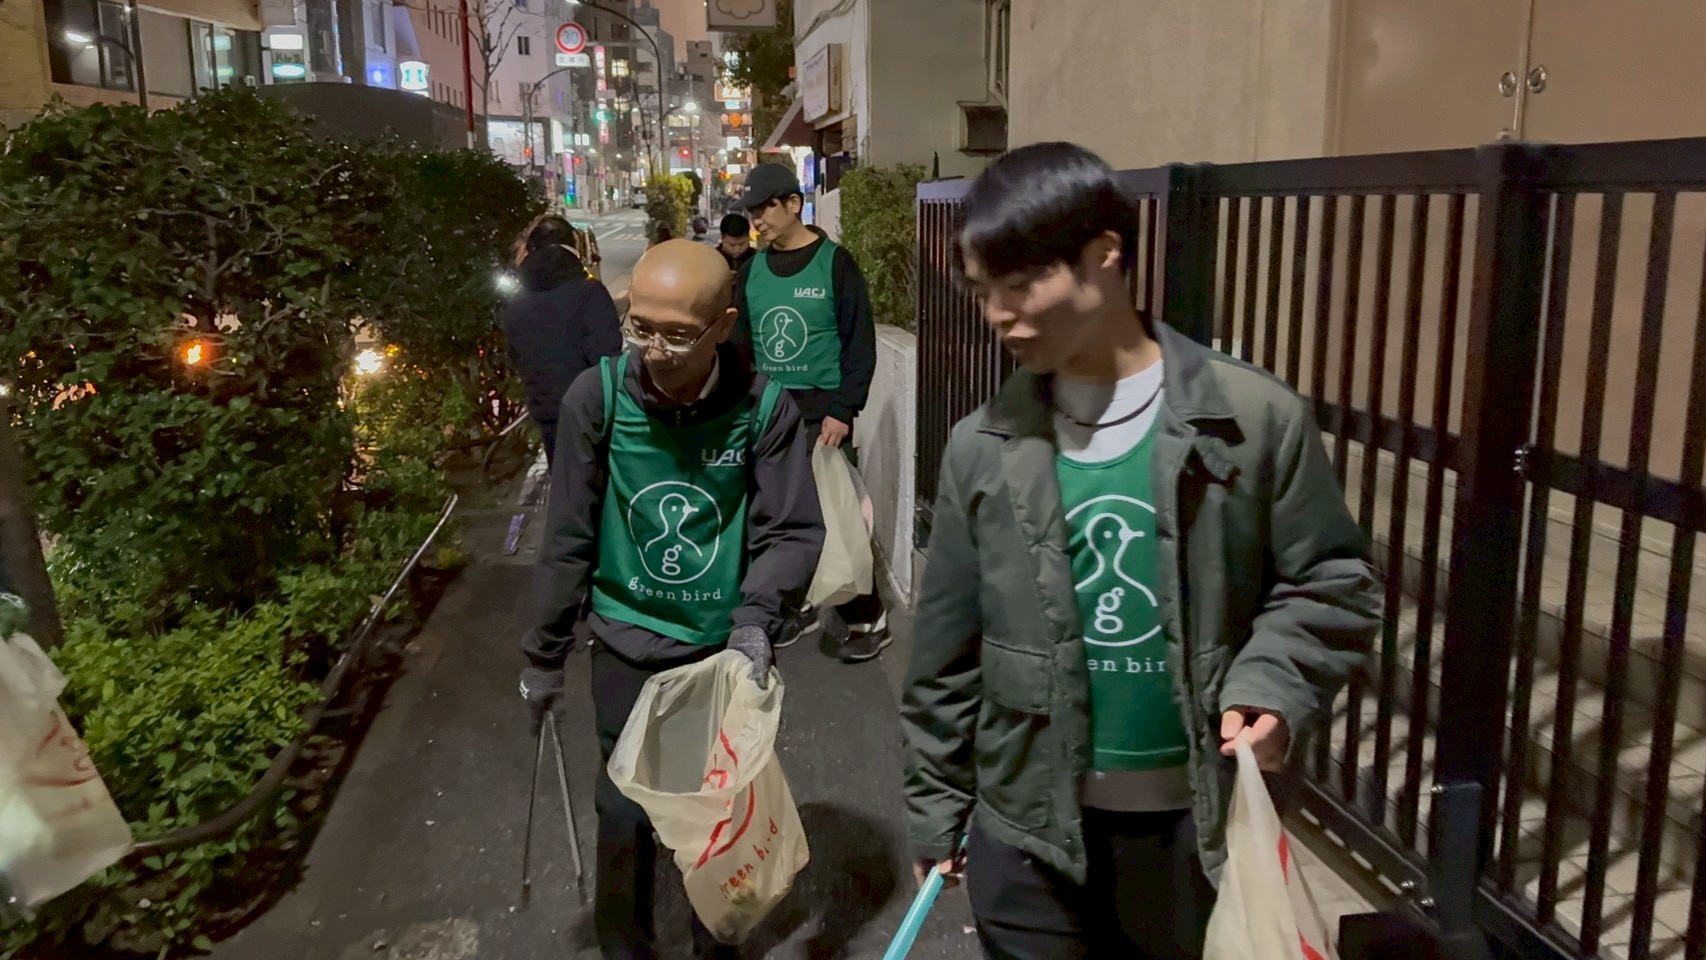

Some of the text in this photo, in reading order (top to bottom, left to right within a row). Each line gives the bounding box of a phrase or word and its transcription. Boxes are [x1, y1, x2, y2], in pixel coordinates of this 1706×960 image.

[563, 30, 579, 45] 30
[793, 287, 826, 299] UACJ
[785, 364, 808, 372] bird
[661, 544, 683, 576] g
[628, 576, 722, 601] green bird
[1094, 587, 1125, 634] g
[1125, 656, 1167, 673] bir
[719, 816, 779, 899] reen bid
